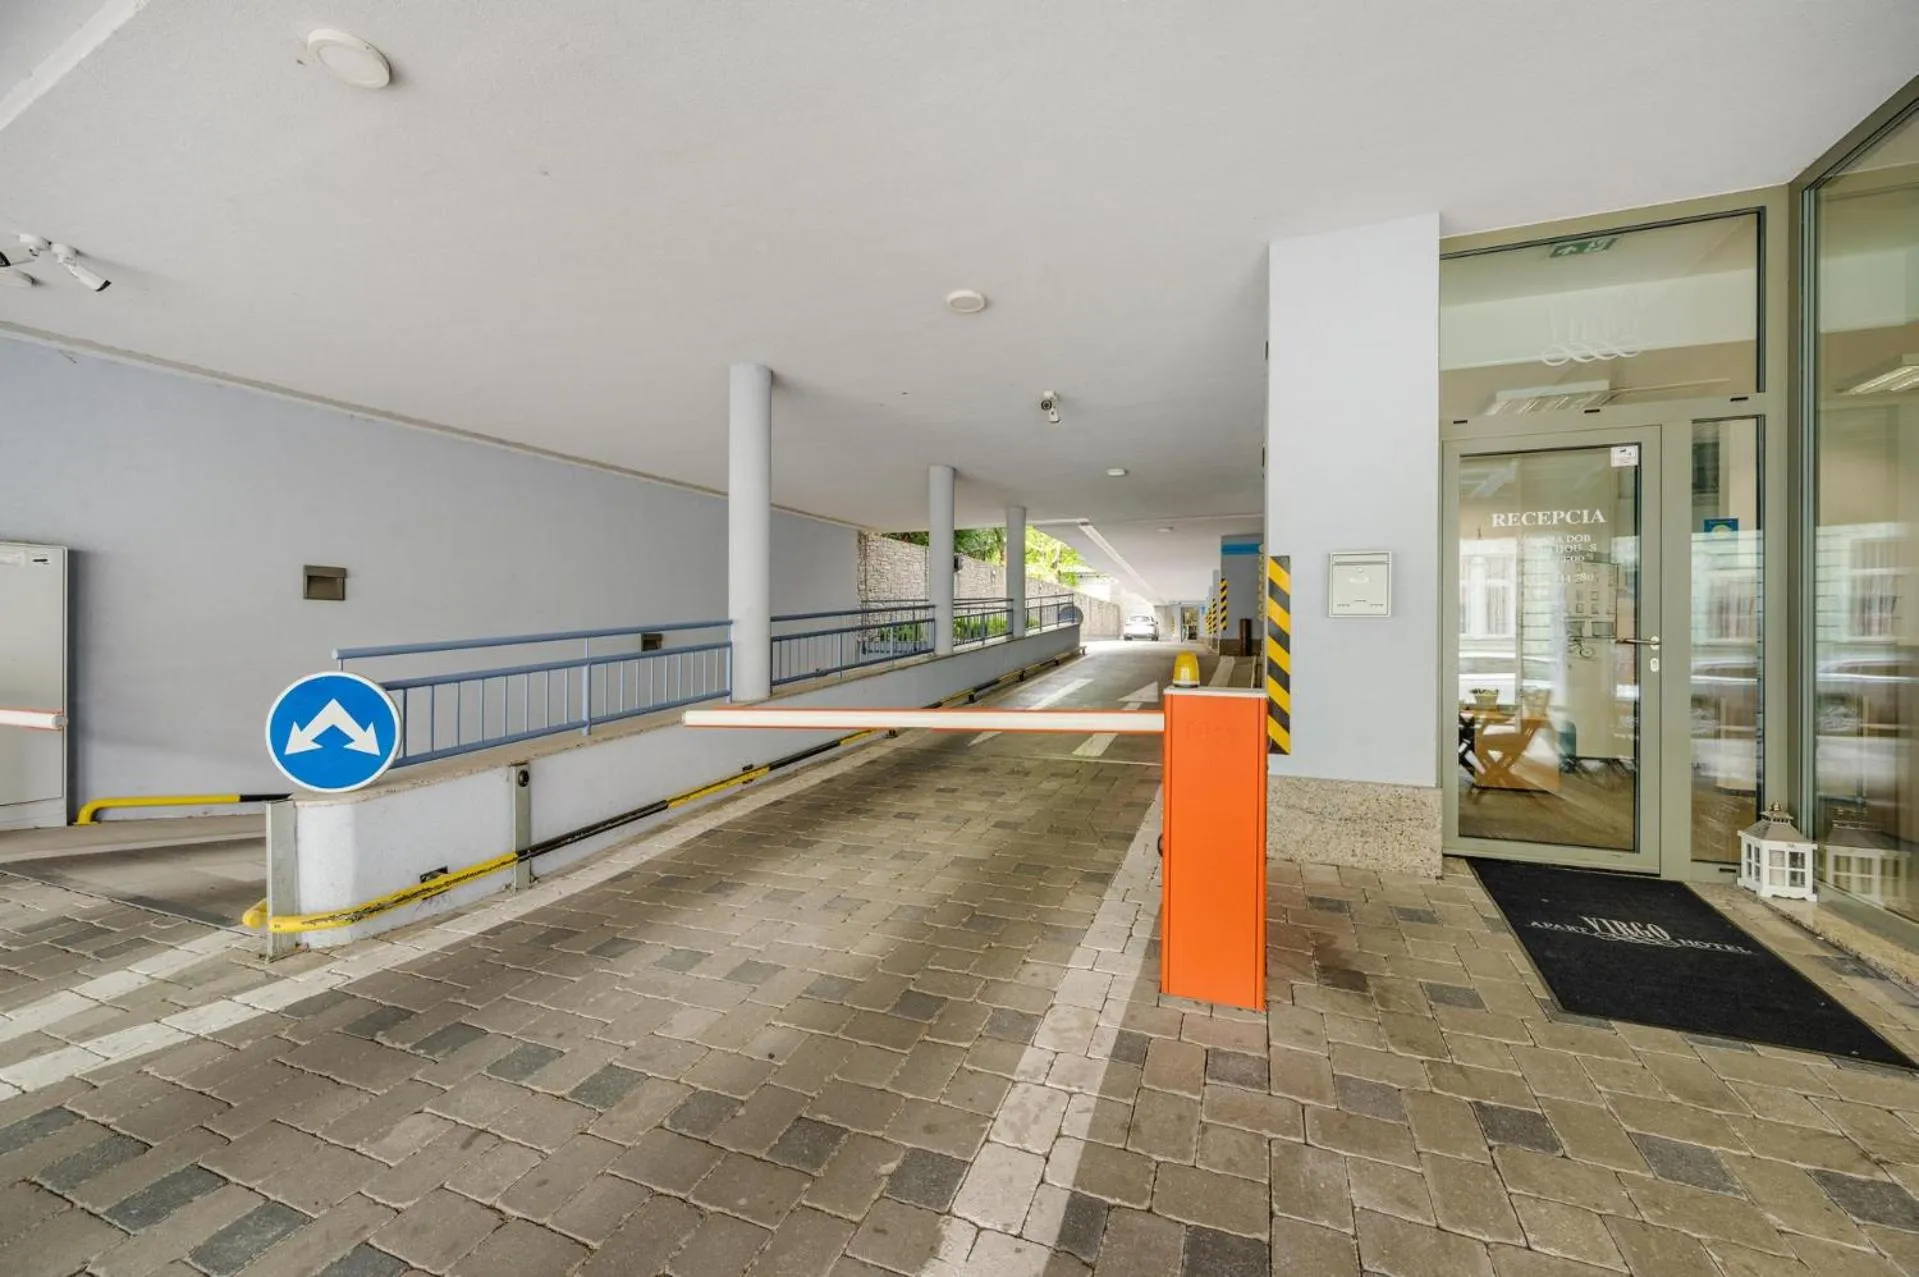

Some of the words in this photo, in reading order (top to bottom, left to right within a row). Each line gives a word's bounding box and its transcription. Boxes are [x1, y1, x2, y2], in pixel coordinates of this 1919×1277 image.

[1491, 508, 1607, 527] RECEPCIA
[1526, 920, 1589, 934] APART
[1578, 915, 1671, 940] VIRGO
[1678, 938, 1755, 956] HOTEL
